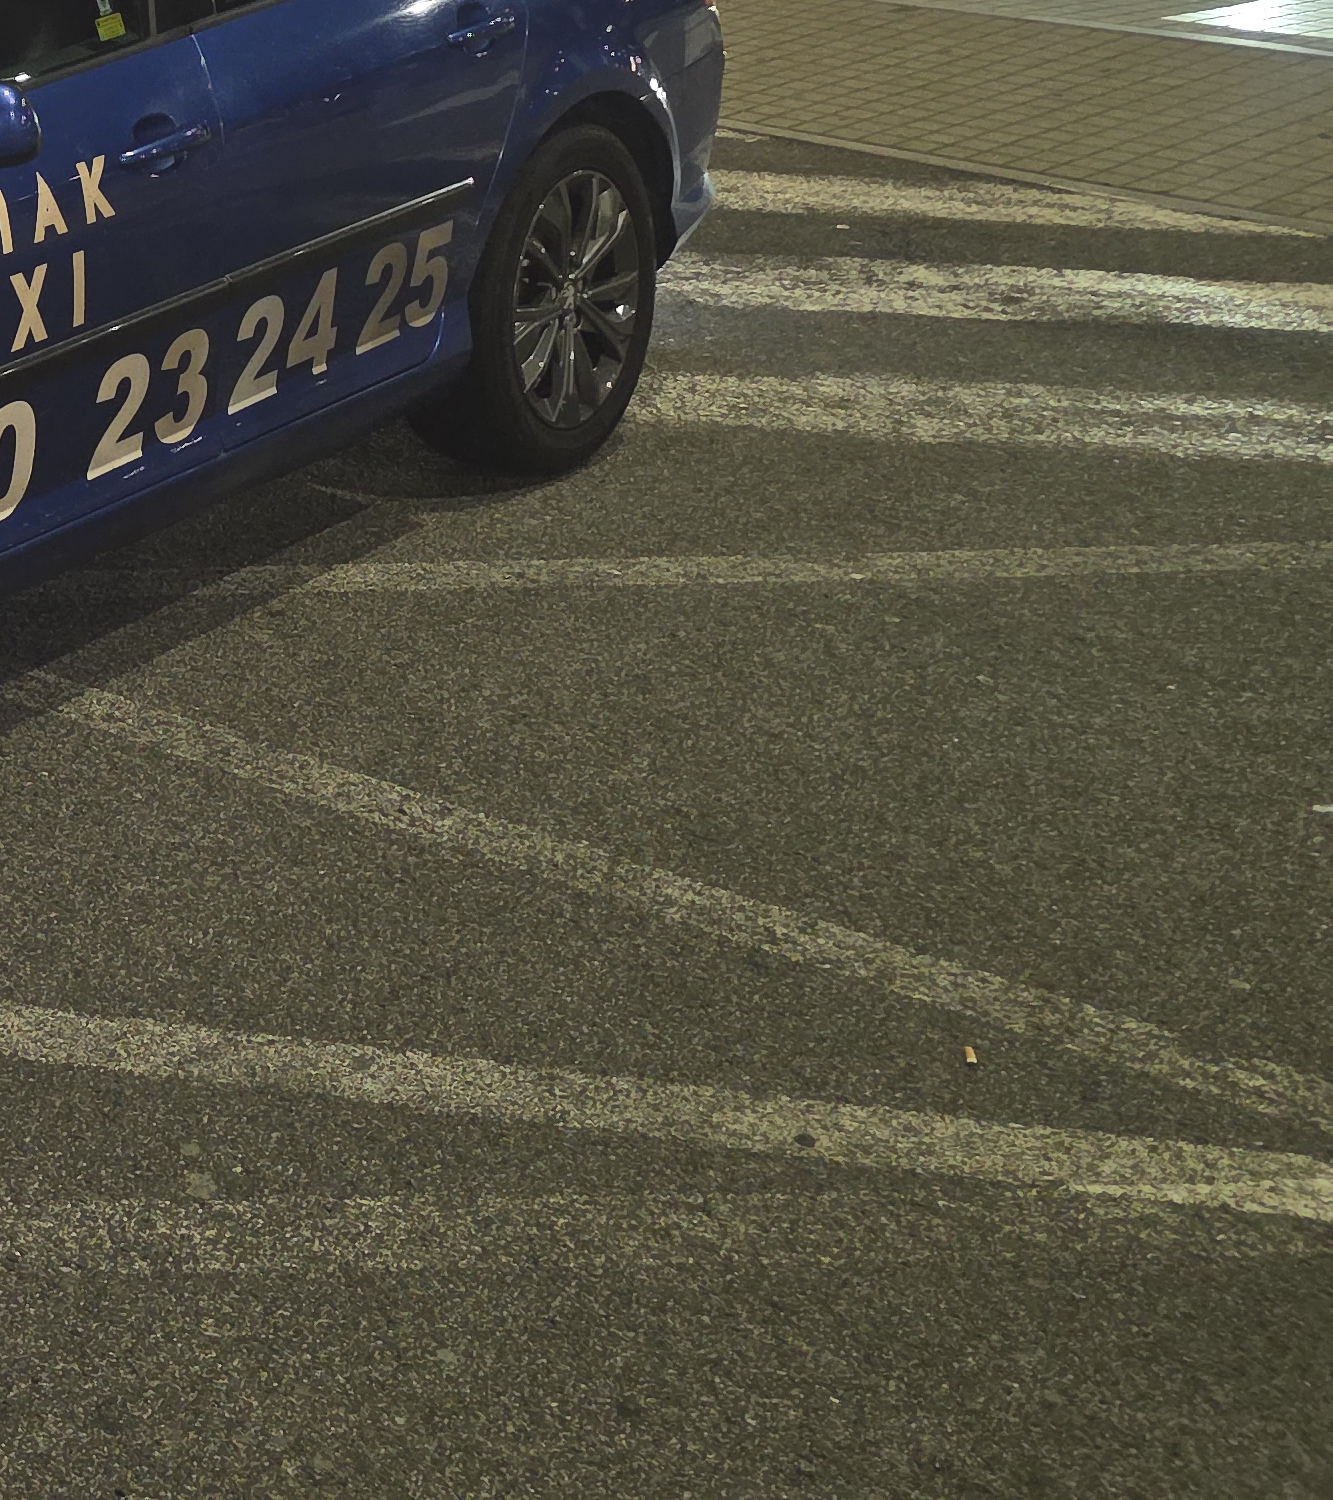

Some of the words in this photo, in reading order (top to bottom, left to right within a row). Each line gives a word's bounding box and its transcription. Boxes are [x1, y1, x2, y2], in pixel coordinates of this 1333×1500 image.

[86, 328, 209, 481] 23
[228, 267, 338, 415] 24
[356, 220, 455, 356] 25
